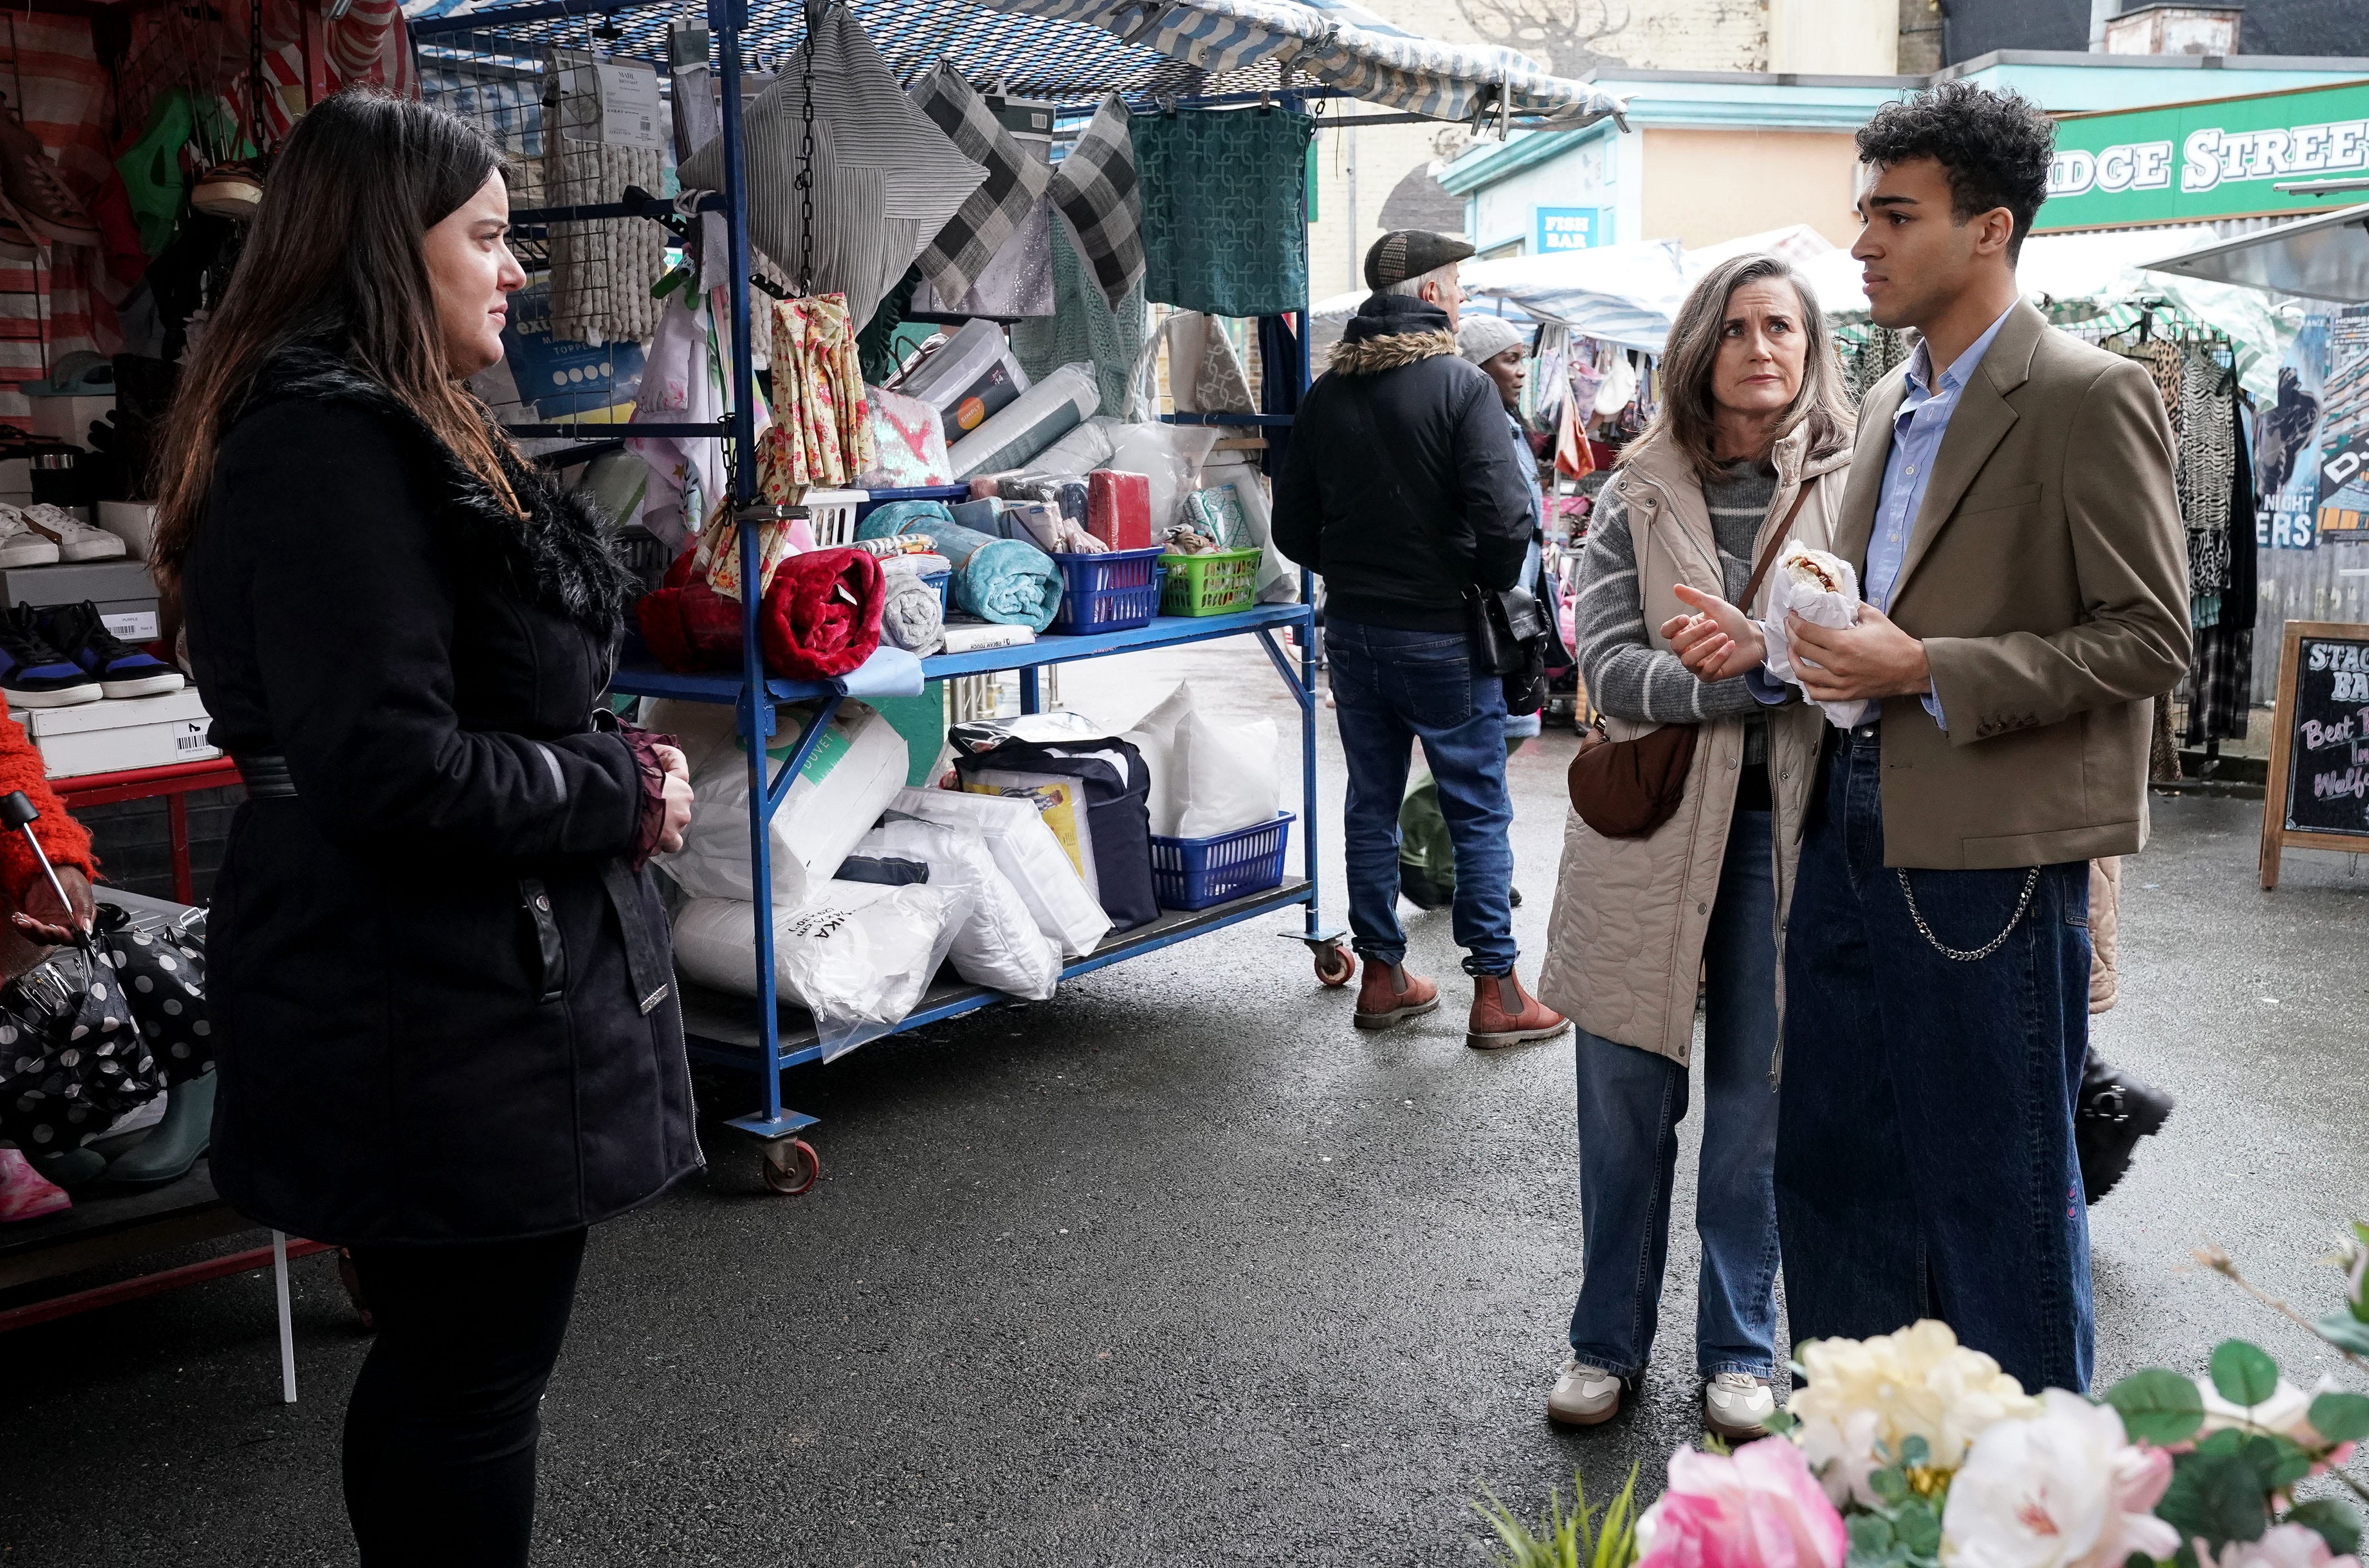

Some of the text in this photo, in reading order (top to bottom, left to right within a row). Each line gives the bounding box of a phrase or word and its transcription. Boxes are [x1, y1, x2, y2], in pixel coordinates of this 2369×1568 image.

[2181, 118, 2369, 193] STREE
[1544, 216, 1589, 232] FISH
[1546, 233, 1587, 249] BAR
[960, 404, 981, 423] SIMPLY
[2263, 494, 2314, 513] NIGHT
[2330, 671, 2369, 702] BA
[2300, 715, 2354, 750] Best
[804, 733, 835, 770] DUVET
[797, 923, 812, 936] cm
[813, 917, 846, 938] IKA
